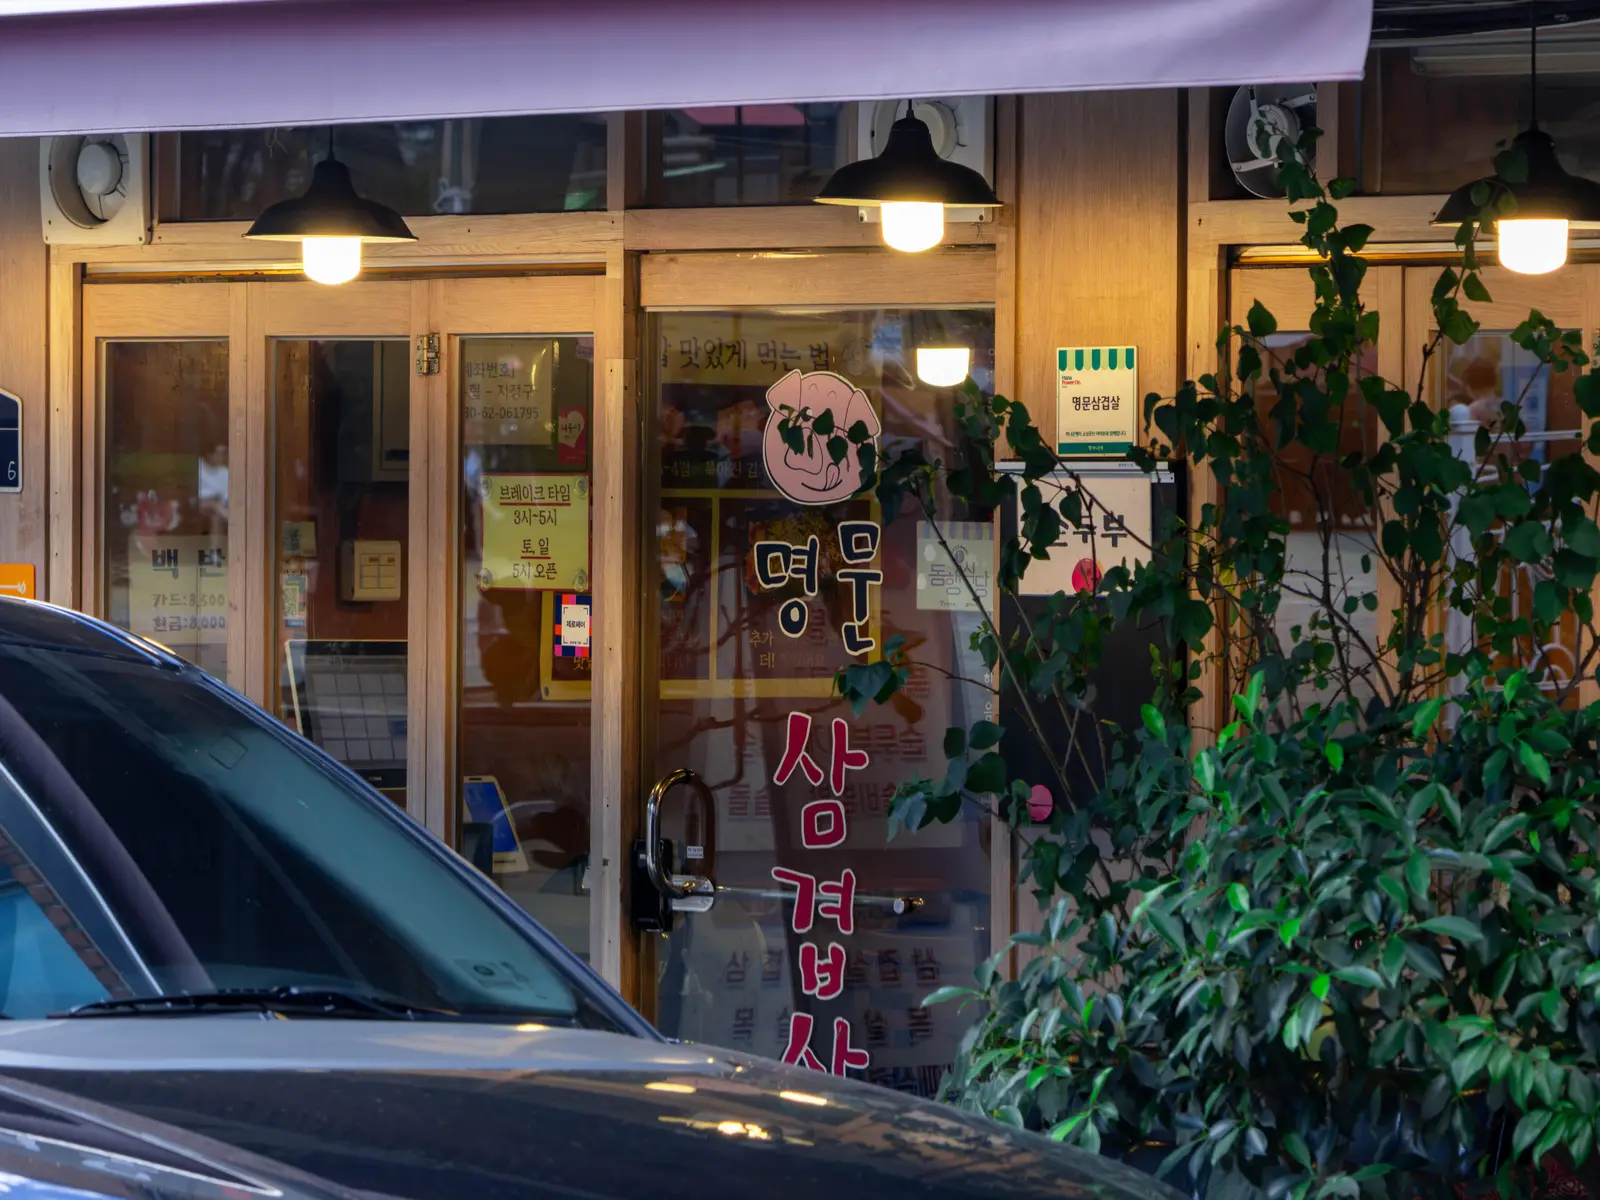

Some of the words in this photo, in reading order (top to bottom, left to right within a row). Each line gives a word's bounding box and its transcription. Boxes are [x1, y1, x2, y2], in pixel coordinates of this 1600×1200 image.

[680, 336, 748, 369] 맛있게
[757, 340, 801, 372] 먹는
[809, 342, 830, 371] 법
[1072, 395, 1120, 411] 명문삼겹살
[7, 461, 17, 481] 6
[500, 484, 545, 501] 브레이크
[548, 484, 570, 502] 타임
[513, 508, 557, 526] 3시~5시
[538, 537, 549, 556] 일
[512, 562, 531, 580] 5시
[534, 562, 557, 580] 오픈
[754, 520, 884, 656] 명문
[566, 620, 585, 629] 제로페이
